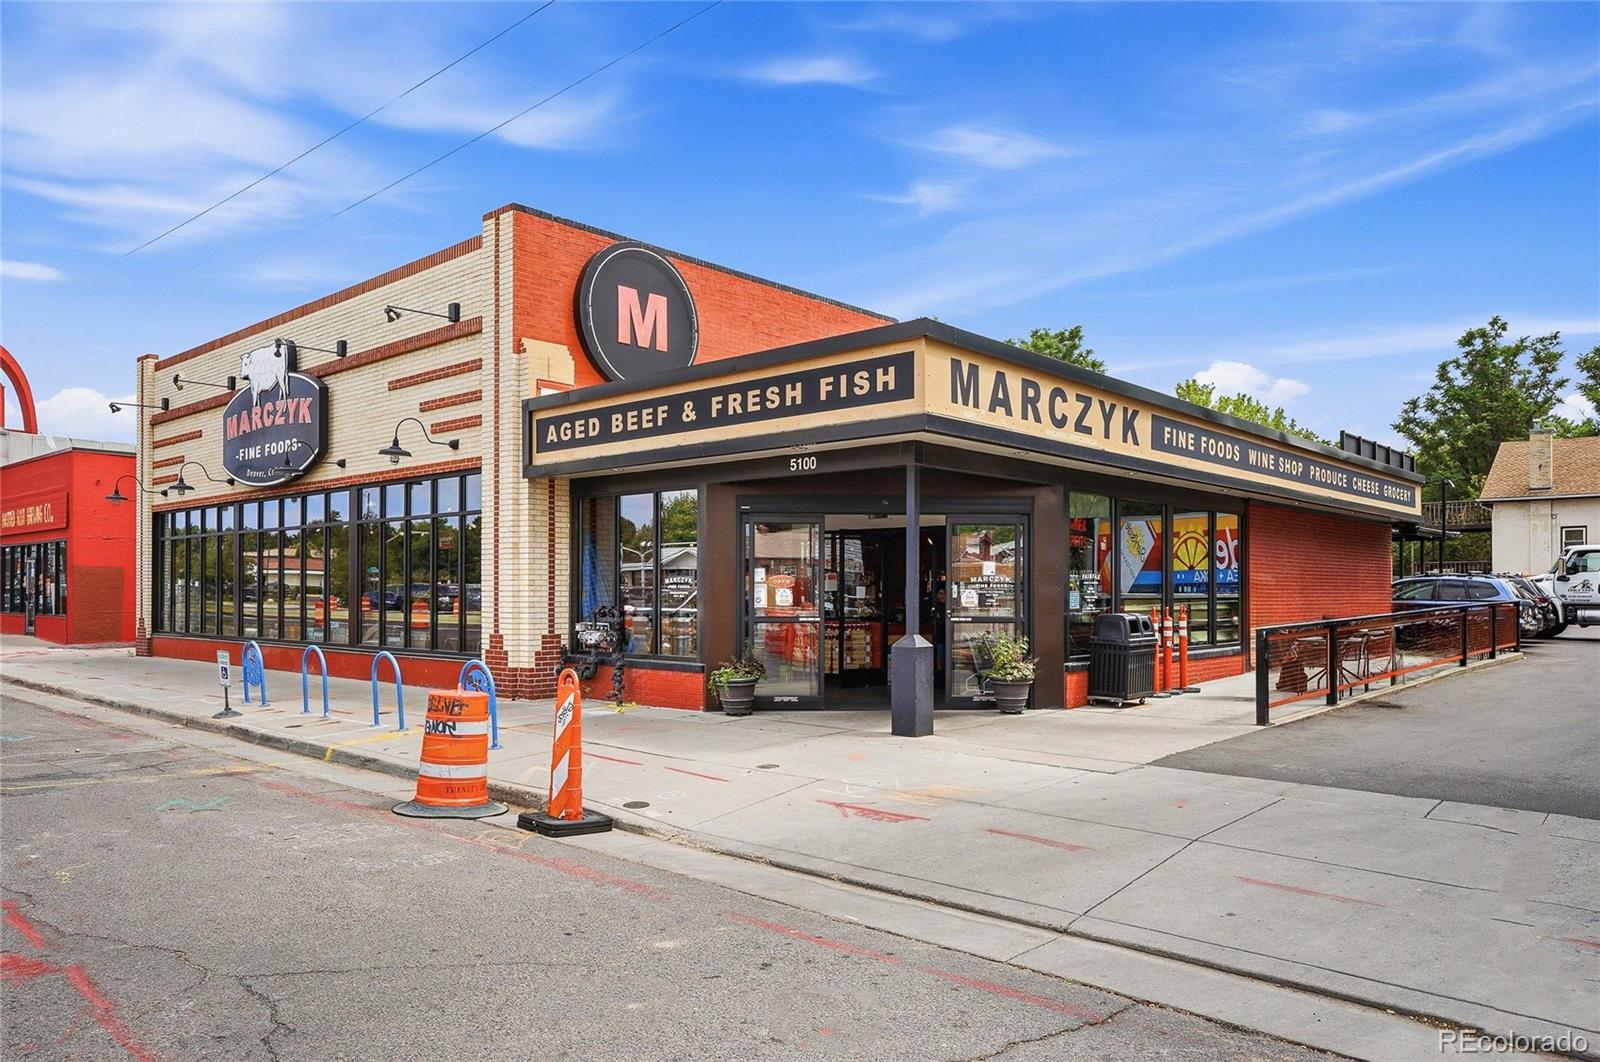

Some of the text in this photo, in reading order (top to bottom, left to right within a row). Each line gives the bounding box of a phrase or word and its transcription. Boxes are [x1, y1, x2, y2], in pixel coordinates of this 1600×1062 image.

[617, 284, 669, 353] M
[226, 397, 313, 440] MARCZYK
[546, 366, 896, 444] AGED BEEF & FRESH FISH
[950, 357, 1141, 447] MARCZYK
[790, 456, 817, 471] 5100
[1164, 426, 1412, 502] FINE FOODS WINE SHOP PRODUCE CHEESE GROCERY
